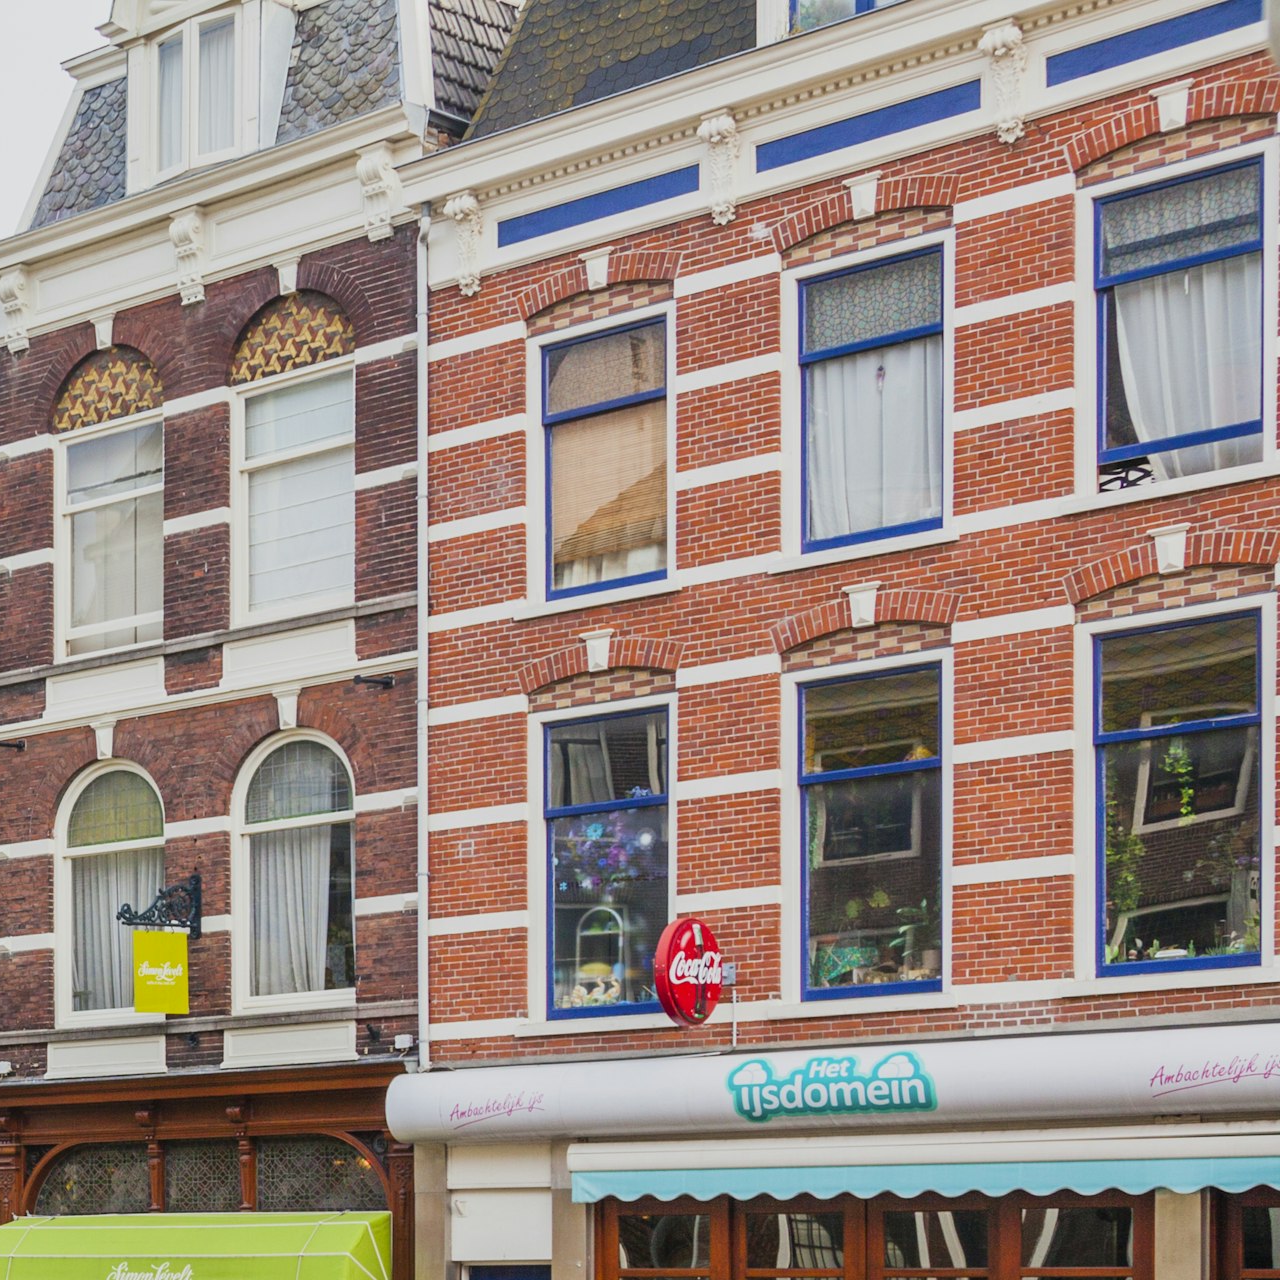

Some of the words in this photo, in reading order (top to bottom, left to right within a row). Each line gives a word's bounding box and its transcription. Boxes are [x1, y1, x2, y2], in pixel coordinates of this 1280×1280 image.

[809, 1060, 851, 1079] Het
[1150, 1053, 1259, 1087] Ambachtelijk
[741, 1074, 927, 1117] ijsdomein
